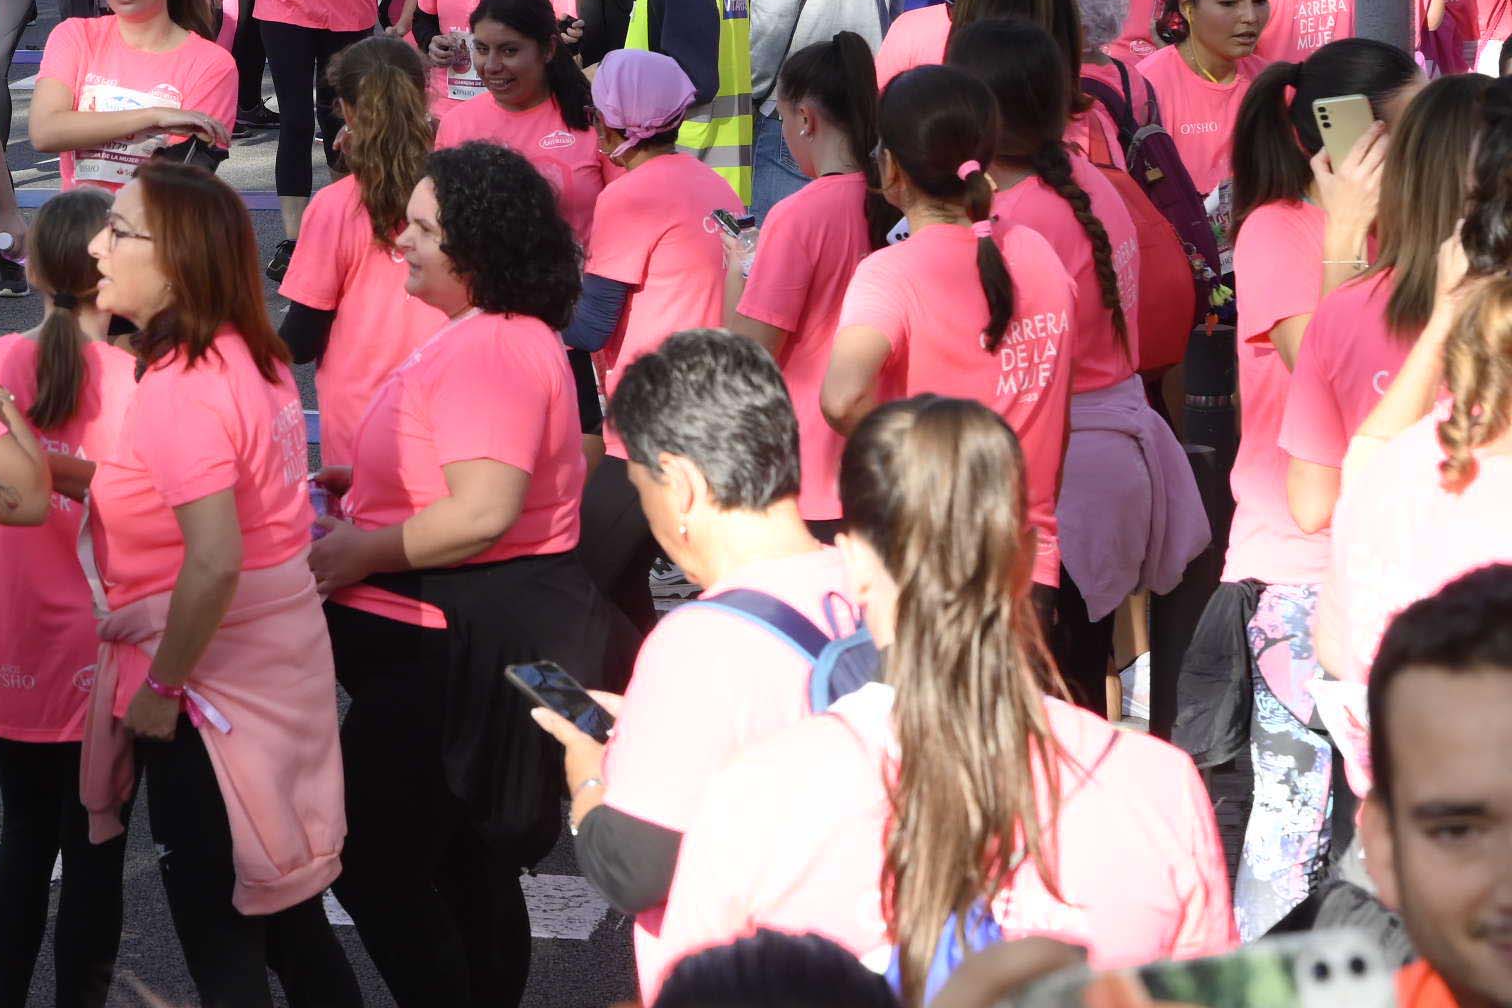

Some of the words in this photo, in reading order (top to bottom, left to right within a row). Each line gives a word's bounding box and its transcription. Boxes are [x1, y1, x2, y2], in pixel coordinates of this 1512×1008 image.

[1300, 17, 1316, 34] DE
[1319, 16, 1336, 33] LA
[1297, 32, 1333, 50] MUJE
[1180, 120, 1219, 135] OYSHO
[1000, 347, 1029, 372] DE
